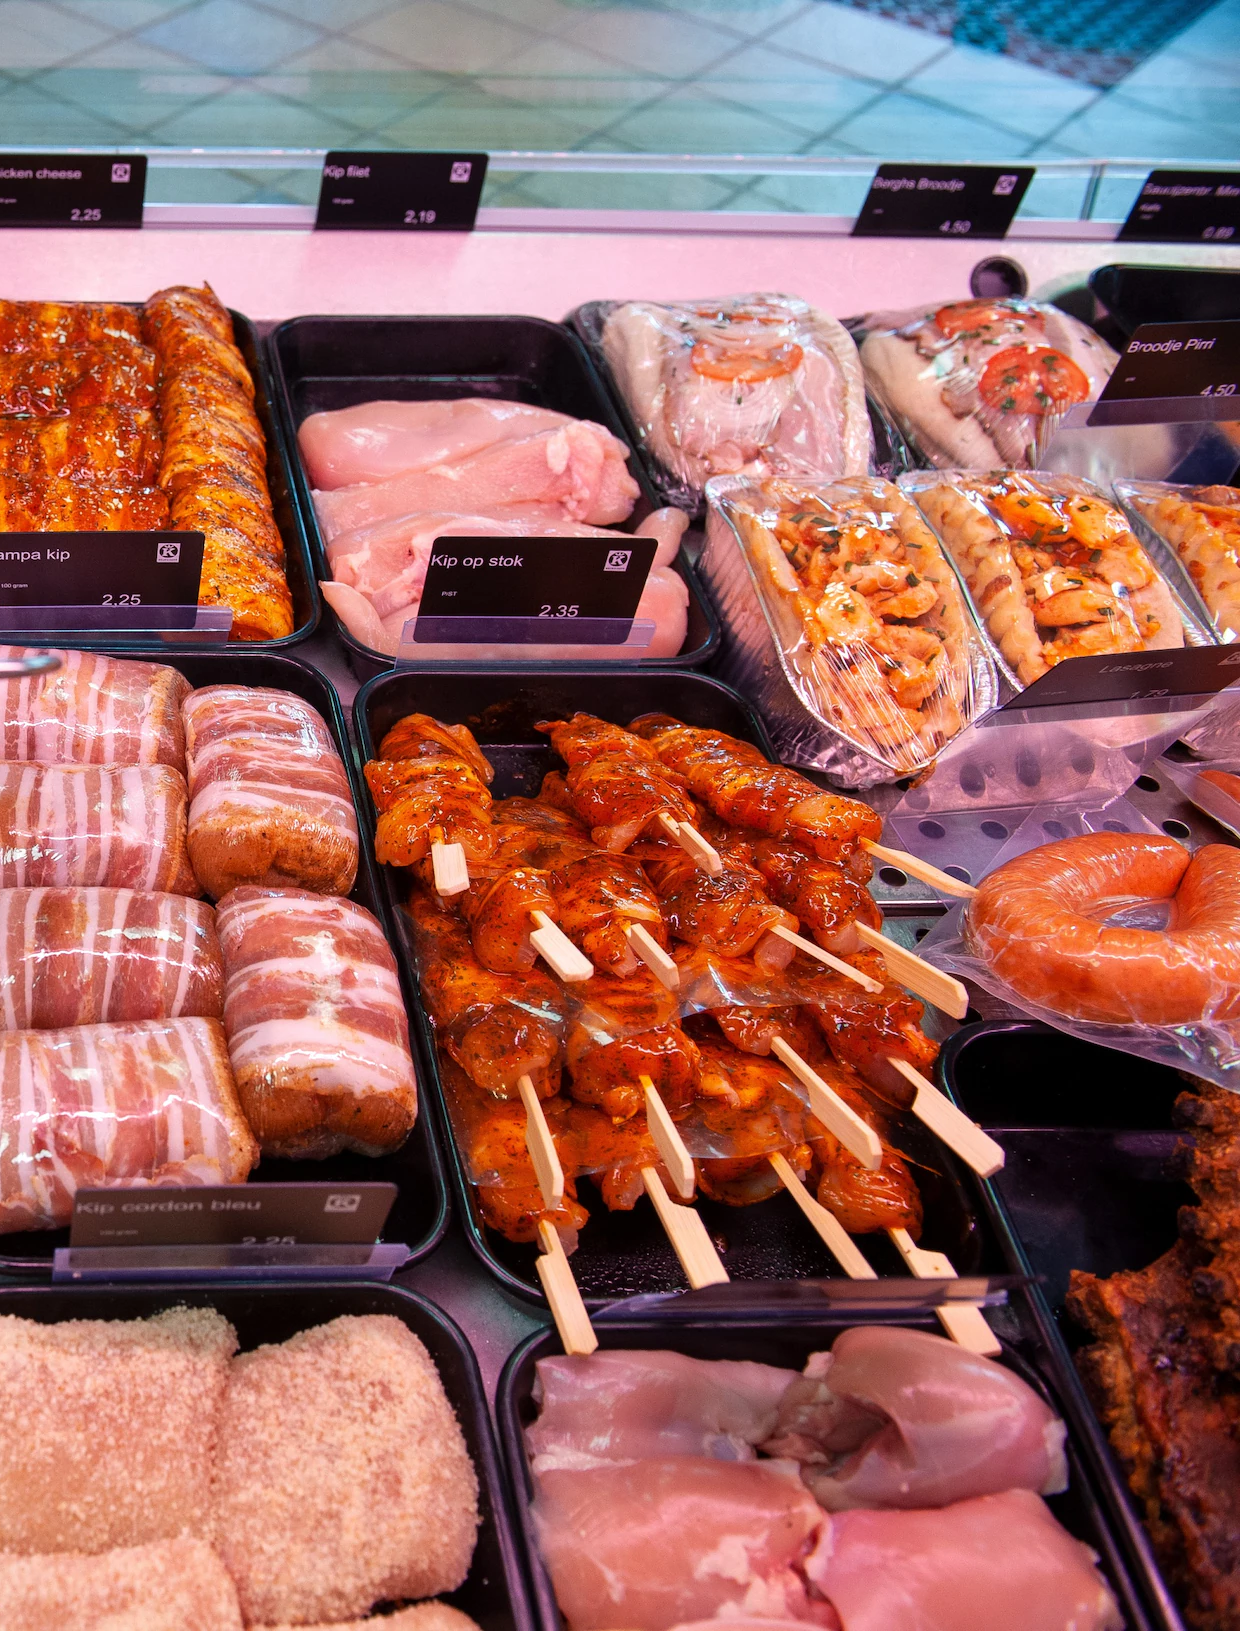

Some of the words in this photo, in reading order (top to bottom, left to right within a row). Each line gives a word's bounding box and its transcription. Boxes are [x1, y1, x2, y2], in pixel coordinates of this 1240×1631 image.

[36, 168, 82, 179] cheese
[324, 165, 345, 179] Kip
[1126, 340, 1182, 354] Broodje
[46, 549, 70, 562] kip
[431, 555, 458, 568] Kip
[462, 557, 484, 569] op
[488, 555, 523, 567] stok
[102, 594, 141, 607] 2,25
[1099, 661, 1174, 674] Lasagne
[76, 1202, 114, 1215] Kip
[122, 1201, 203, 1213] cordon
[210, 1199, 261, 1211] bleu
[242, 1236, 296, 1247] 225
